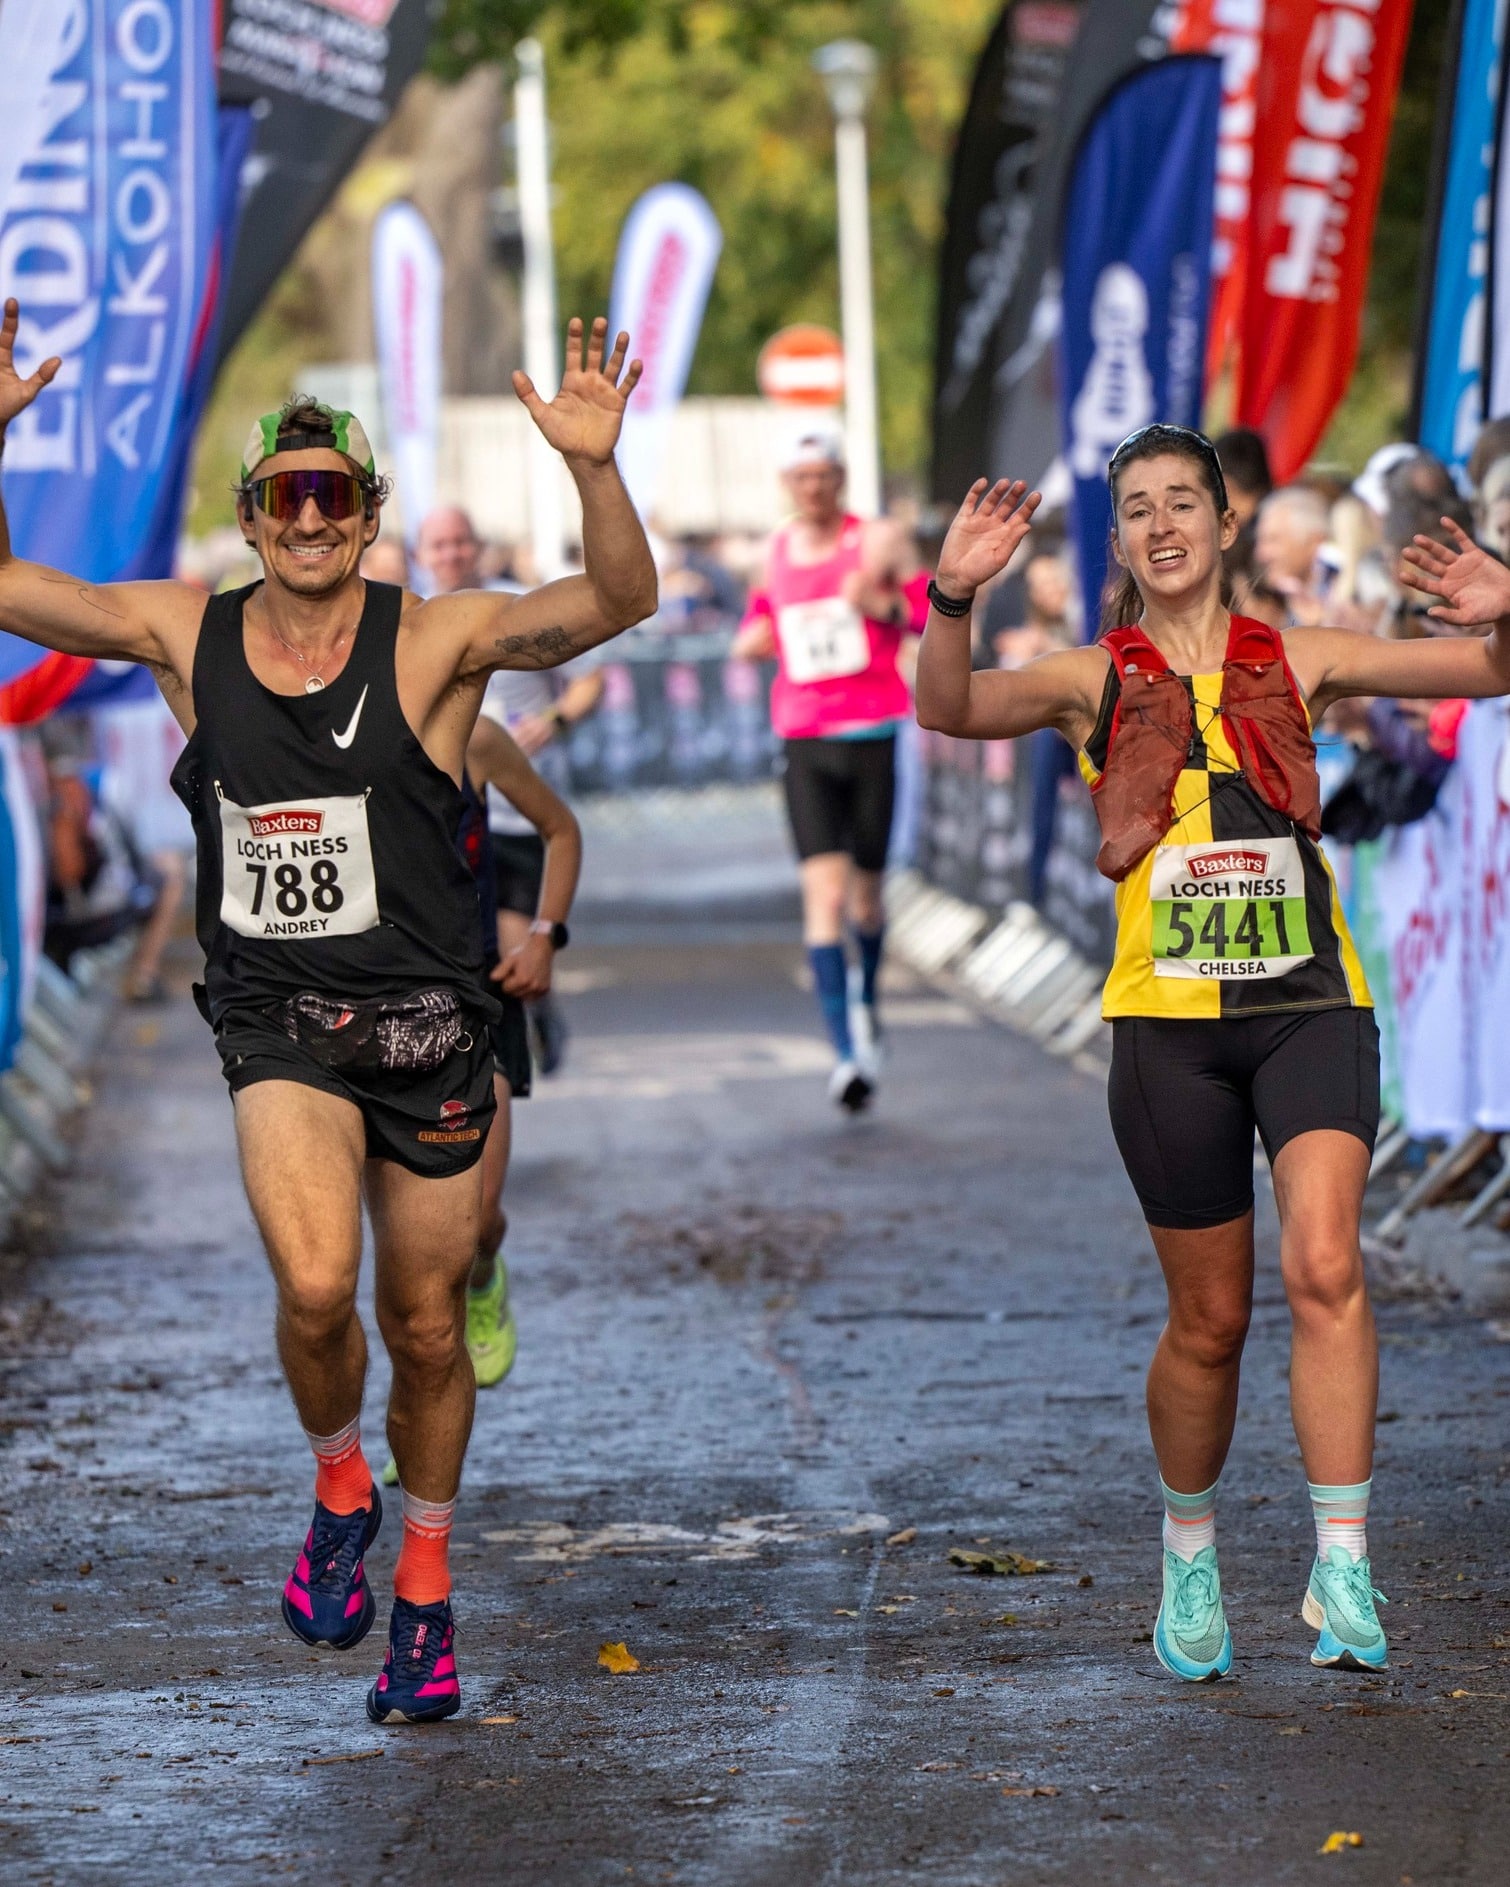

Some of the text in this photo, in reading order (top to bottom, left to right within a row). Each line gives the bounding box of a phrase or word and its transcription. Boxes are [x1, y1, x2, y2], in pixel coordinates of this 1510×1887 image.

[250, 814, 319, 835] Baxters
[237, 837, 348, 860] LOCH NESS
[1192, 854, 1264, 877] Baxters
[246, 859, 344, 917] 788
[1170, 879, 1286, 897] LOCH NESS
[263, 918, 329, 935] ANDREY
[1166, 901, 1291, 958] 5441
[1199, 961, 1267, 976] CHELSEA
